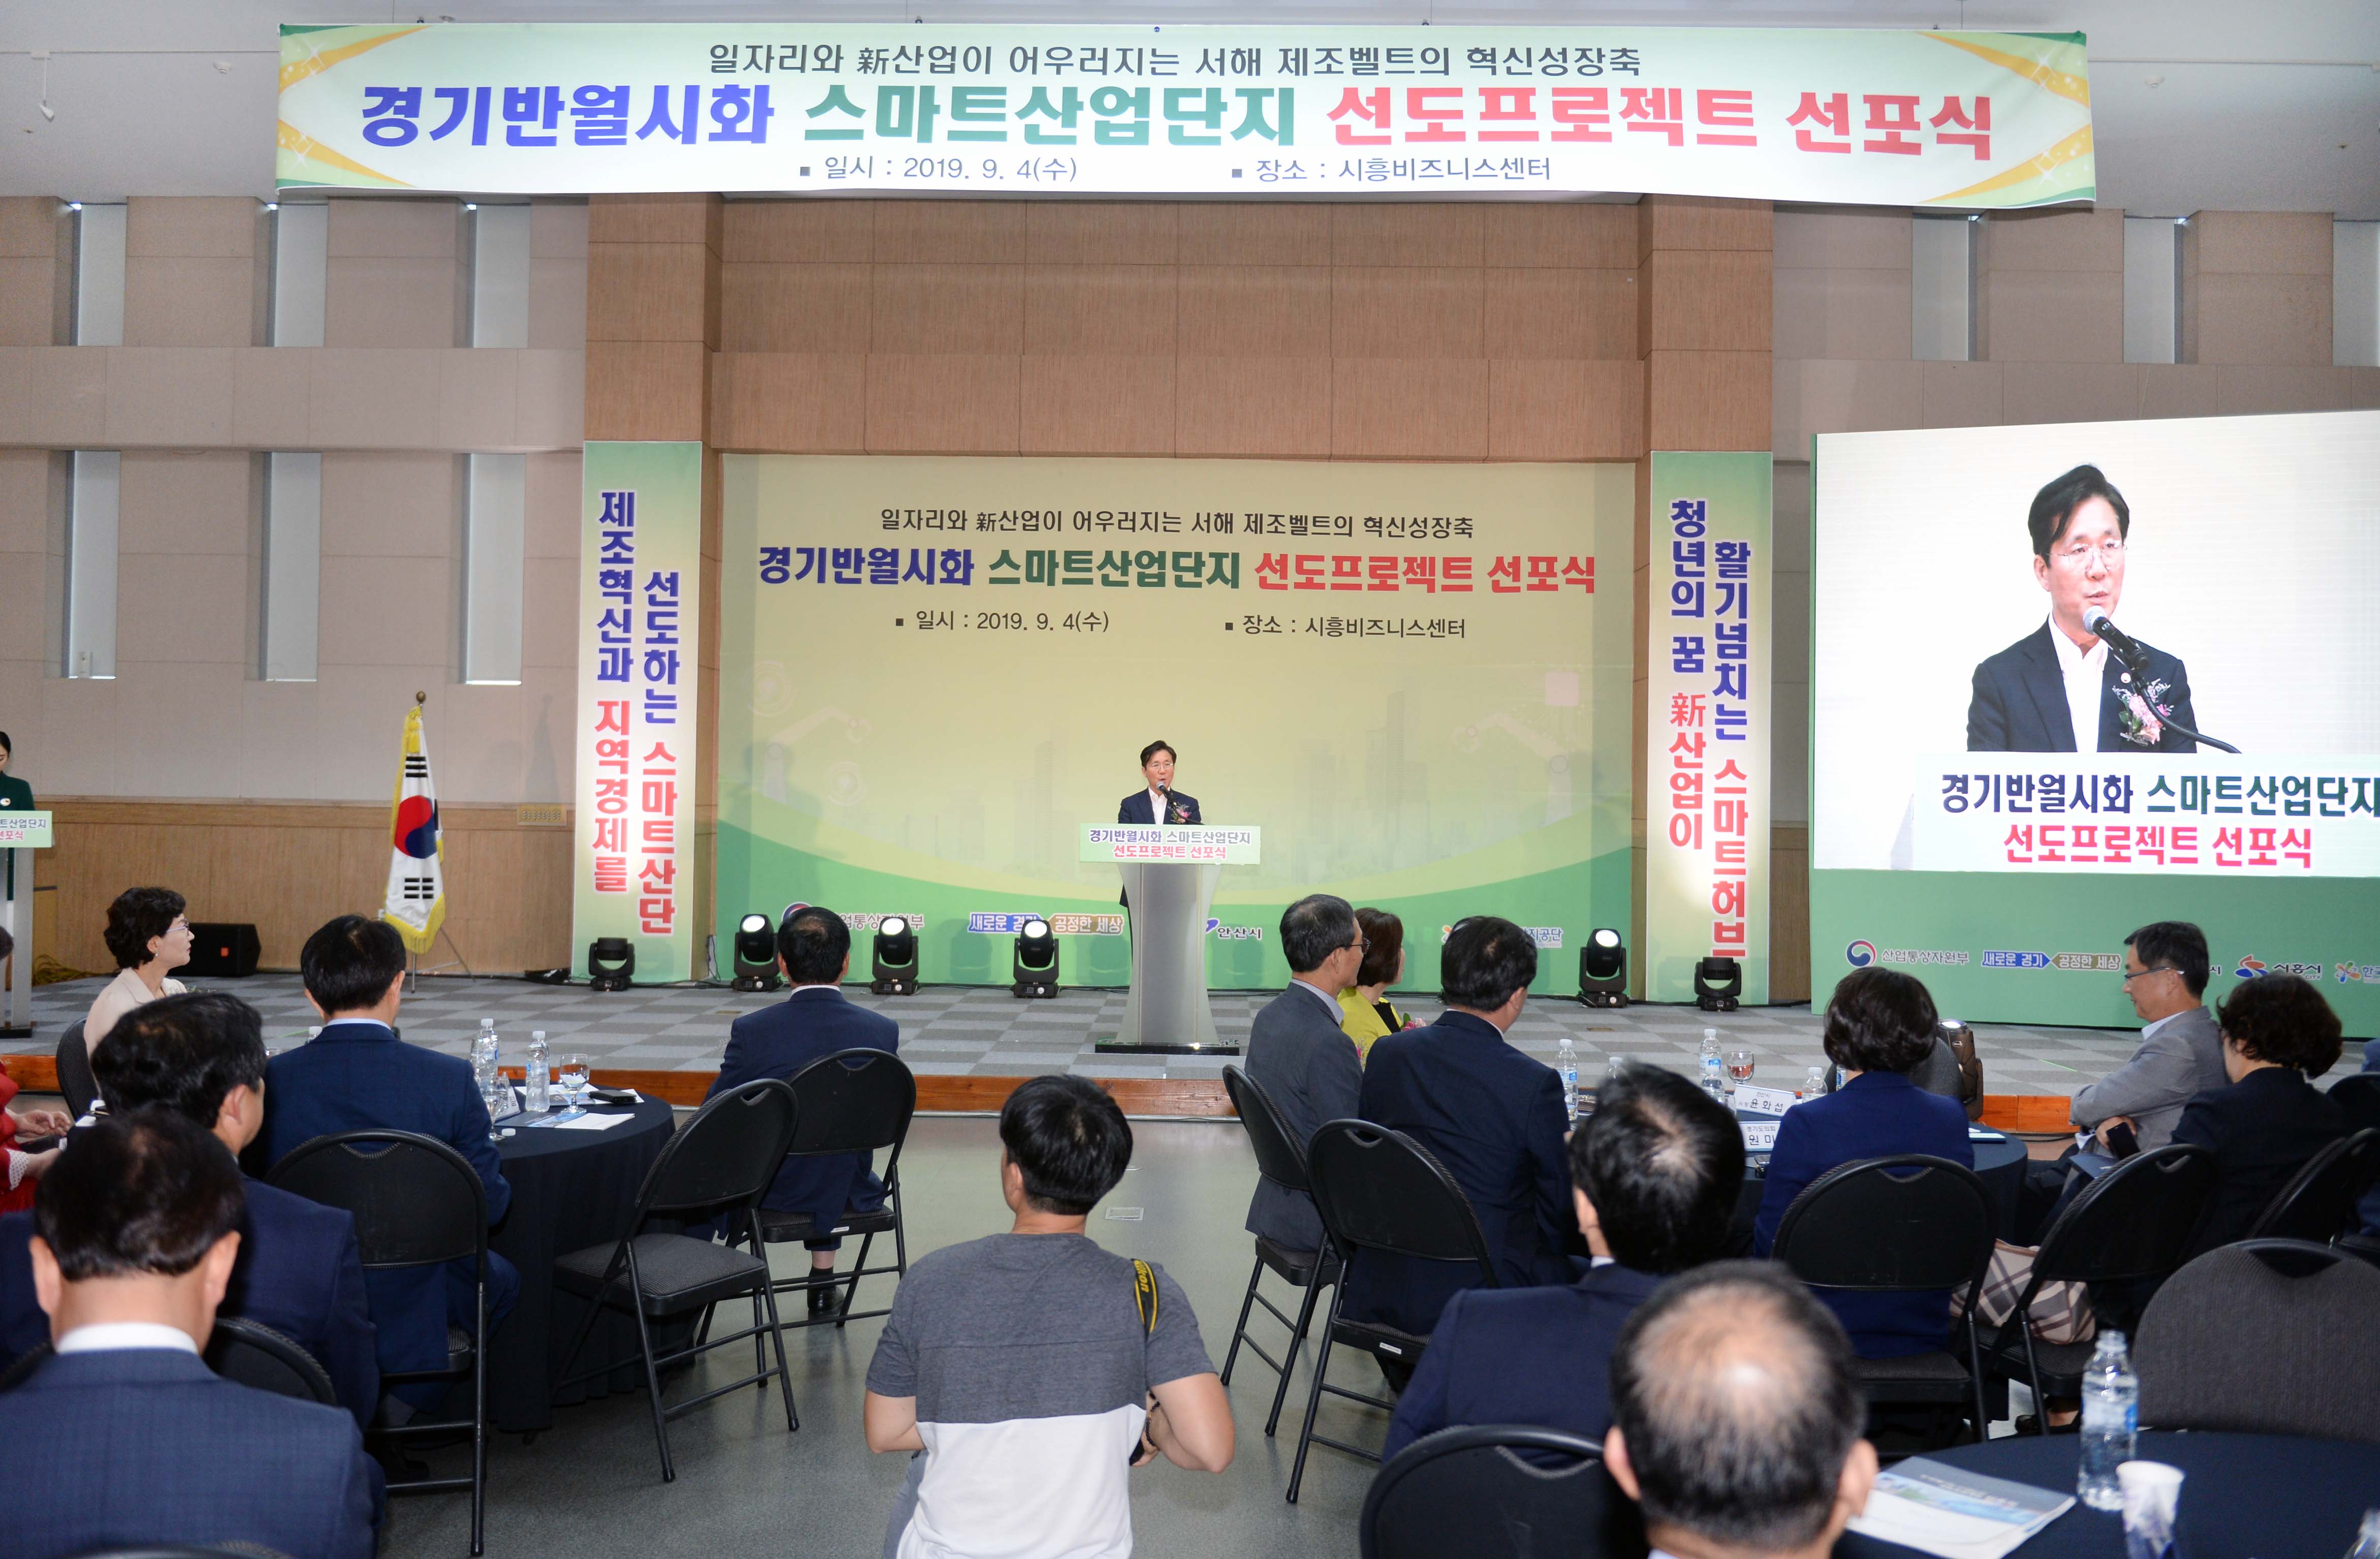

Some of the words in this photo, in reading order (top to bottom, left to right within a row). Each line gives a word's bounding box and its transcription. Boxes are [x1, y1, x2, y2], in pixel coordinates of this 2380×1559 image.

[710, 44, 844, 74] 일자리와
[857, 45, 991, 75] 新산업이
[1010, 46, 1179, 76] 어우러지는
[1195, 48, 1261, 76] 서해
[1277, 47, 1449, 76] 제조벨트의
[1467, 47, 1640, 77] 혁신성장축
[362, 84, 774, 147] 경기반월시화
[804, 84, 1294, 146] 스마트산업단지
[1327, 87, 1757, 147] 선도프로젝트
[1786, 92, 1991, 161] 선포식
[825, 155, 873, 179] 일시
[903, 158, 969, 179] 2019.
[983, 159, 1004, 179] 9.
[1017, 157, 1077, 182] 4(수)
[1256, 160, 1307, 182] 장소
[1339, 157, 1550, 181] 시흥비즈니스센터
[882, 509, 968, 531] 일자리와
[976, 510, 1061, 532] 新산업이
[1073, 511, 1181, 533] 어우러지는
[1191, 512, 1233, 534] 서해
[1243, 513, 1353, 536] 제조벨트의
[1364, 516, 1474, 539] 혁신성장축
[759, 547, 975, 586] 경기반월시화
[989, 549, 1240, 589] 스마트산업단지
[1254, 552, 1473, 594] 선도프로젝트
[1487, 556, 1594, 594] 선포식
[1670, 500, 1705, 618] 청년의
[597, 492, 635, 682] 제조혁신과
[916, 610, 954, 630] 일시
[977, 612, 1027, 631] 2019.
[1037, 613, 1053, 631] 9.
[1063, 611, 1109, 633] 4(수)
[1243, 614, 1282, 635] 장소
[1305, 616, 1465, 639] 시흥비즈니스센터
[643, 572, 680, 724] 선도하는
[1672, 636, 1705, 673] 꿈
[1712, 542, 1751, 740] 활기넘치는
[1669, 692, 1706, 849] 新산업이
[592, 700, 630, 892] 지역경제를
[1942, 774, 2134, 814] 경기반월시화
[2147, 775, 2380, 818] 스마트산업단지
[638, 742, 677, 934] 스마트산단
[1090, 830, 1162, 843] 경기반월시화
[1167, 831, 1250, 845] 스마트산업단지
[1113, 845, 1185, 858] 선도프로젝트
[1190, 846, 1226, 859] 선포식
[2004, 824, 2198, 865] 선도프로젝트
[2212, 827, 2311, 868] 선포식
[1712, 759, 1748, 957] 스마트허브
[840, 914, 923, 930] 업통상부
[970, 915, 1007, 931] 새로운
[1055, 915, 1092, 932] 공정한
[1096, 916, 1121, 933] 세상
[1217, 927, 1261, 939] 안산시
[1525, 928, 1562, 941] 지공단
[1882, 950, 1968, 964] 산업통상자원부
[1984, 952, 2016, 966] 새로운
[2021, 952, 2043, 968] 경기
[2059, 954, 2092, 969] 공정한
[2096, 955, 2119, 970] 세상
[2273, 964, 2321, 974] 시흥시
